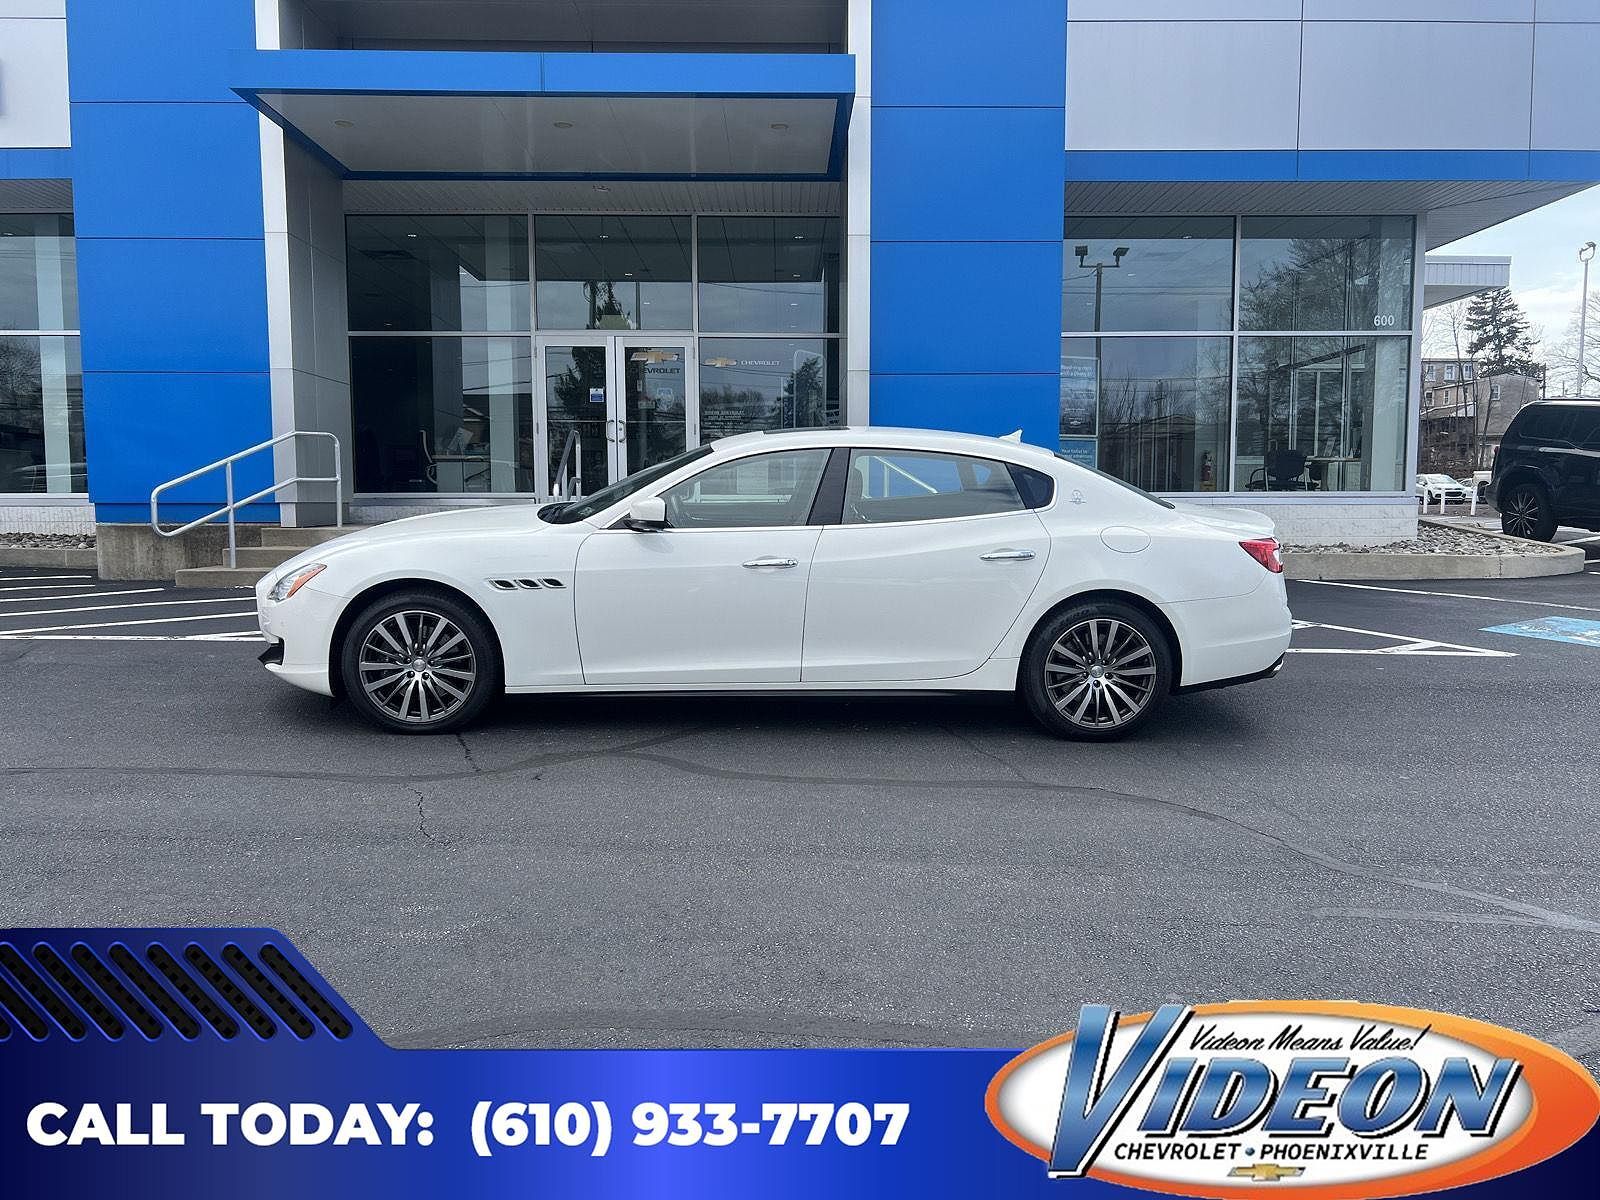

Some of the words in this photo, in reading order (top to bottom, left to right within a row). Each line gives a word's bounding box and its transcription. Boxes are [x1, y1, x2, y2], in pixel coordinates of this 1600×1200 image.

[1373, 314, 1395, 327] 600
[740, 359, 781, 367] CHEVROLET
[643, 367, 681, 375] EVROLET
